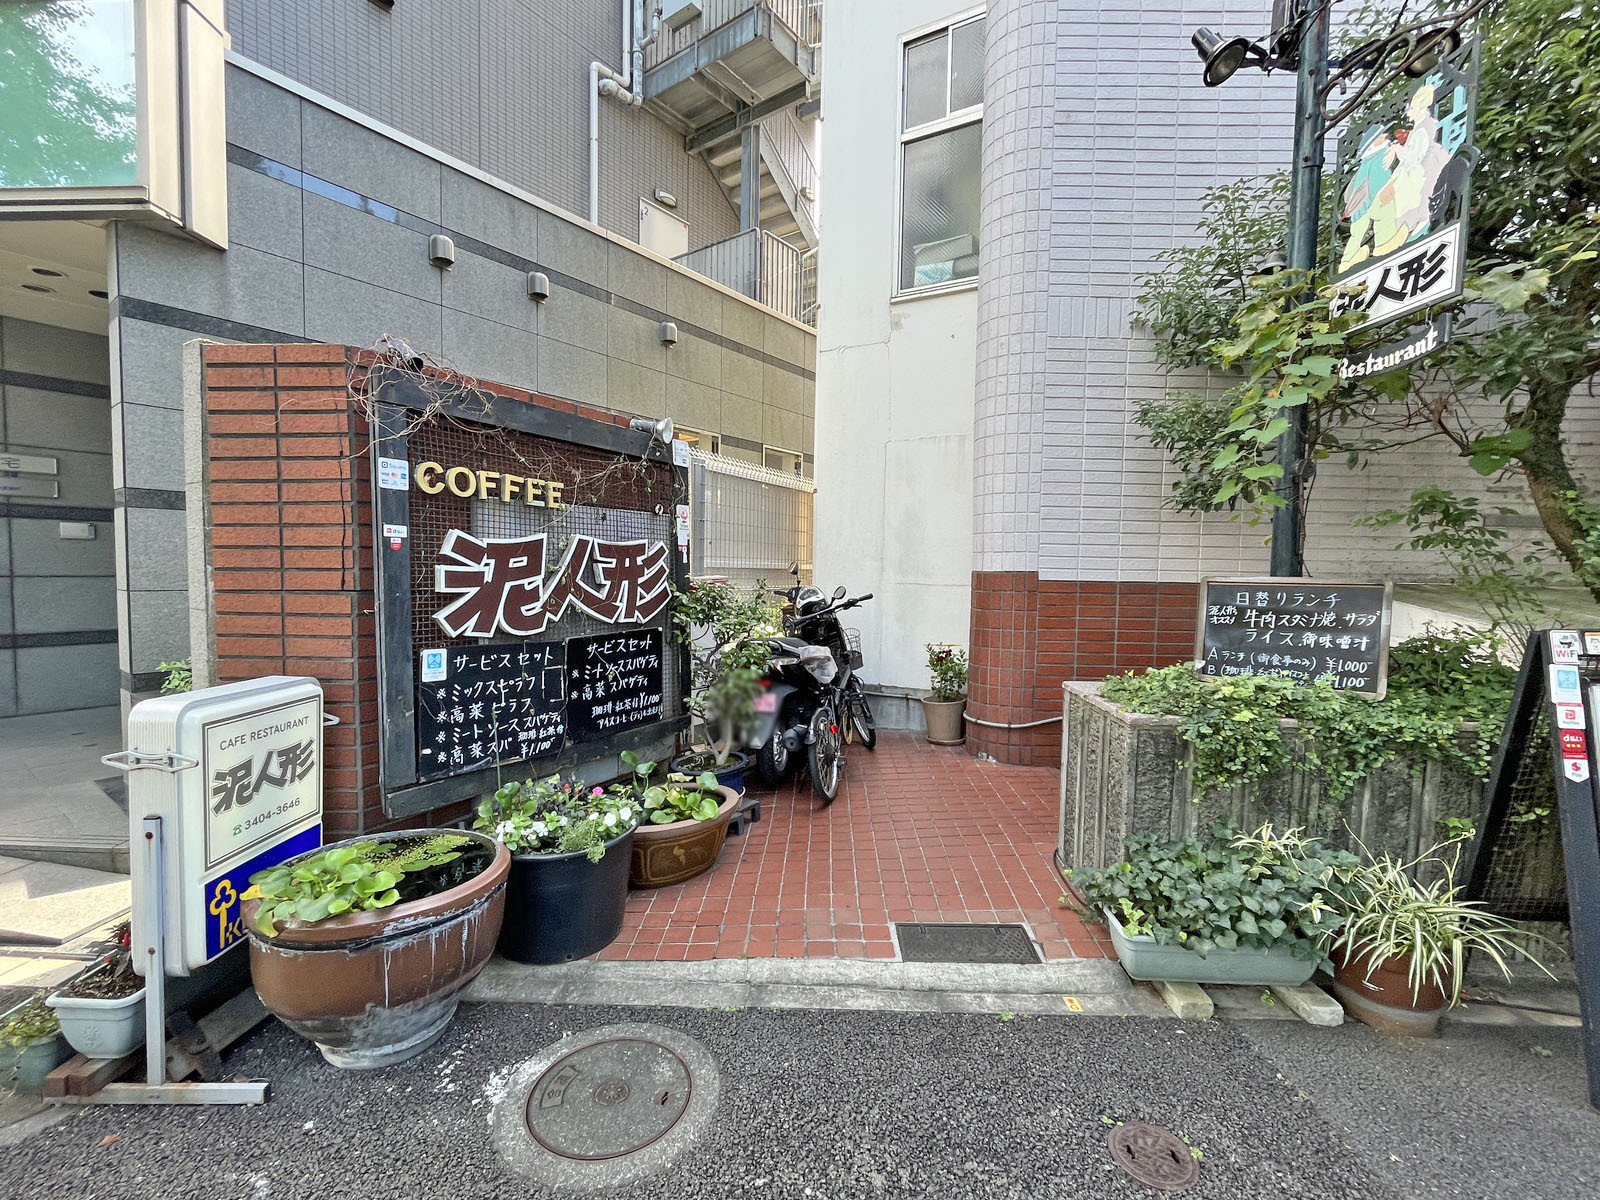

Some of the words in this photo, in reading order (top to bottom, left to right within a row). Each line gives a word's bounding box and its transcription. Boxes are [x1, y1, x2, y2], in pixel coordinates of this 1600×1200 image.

[1338, 322, 1438, 379] Restaurant
[414, 461, 565, 509] COFFEE
[432, 528, 673, 638] 泥人形
[1236, 591, 1341, 609] 日替りランチ
[453, 646, 553, 672] サービスセット
[587, 634, 653, 659] サービスセット
[219, 734, 247, 751] CAFE
[249, 716, 309, 742] RESTAURANT
[210, 739, 315, 817] 泥人形
[244, 797, 301, 831] 3404-3646
